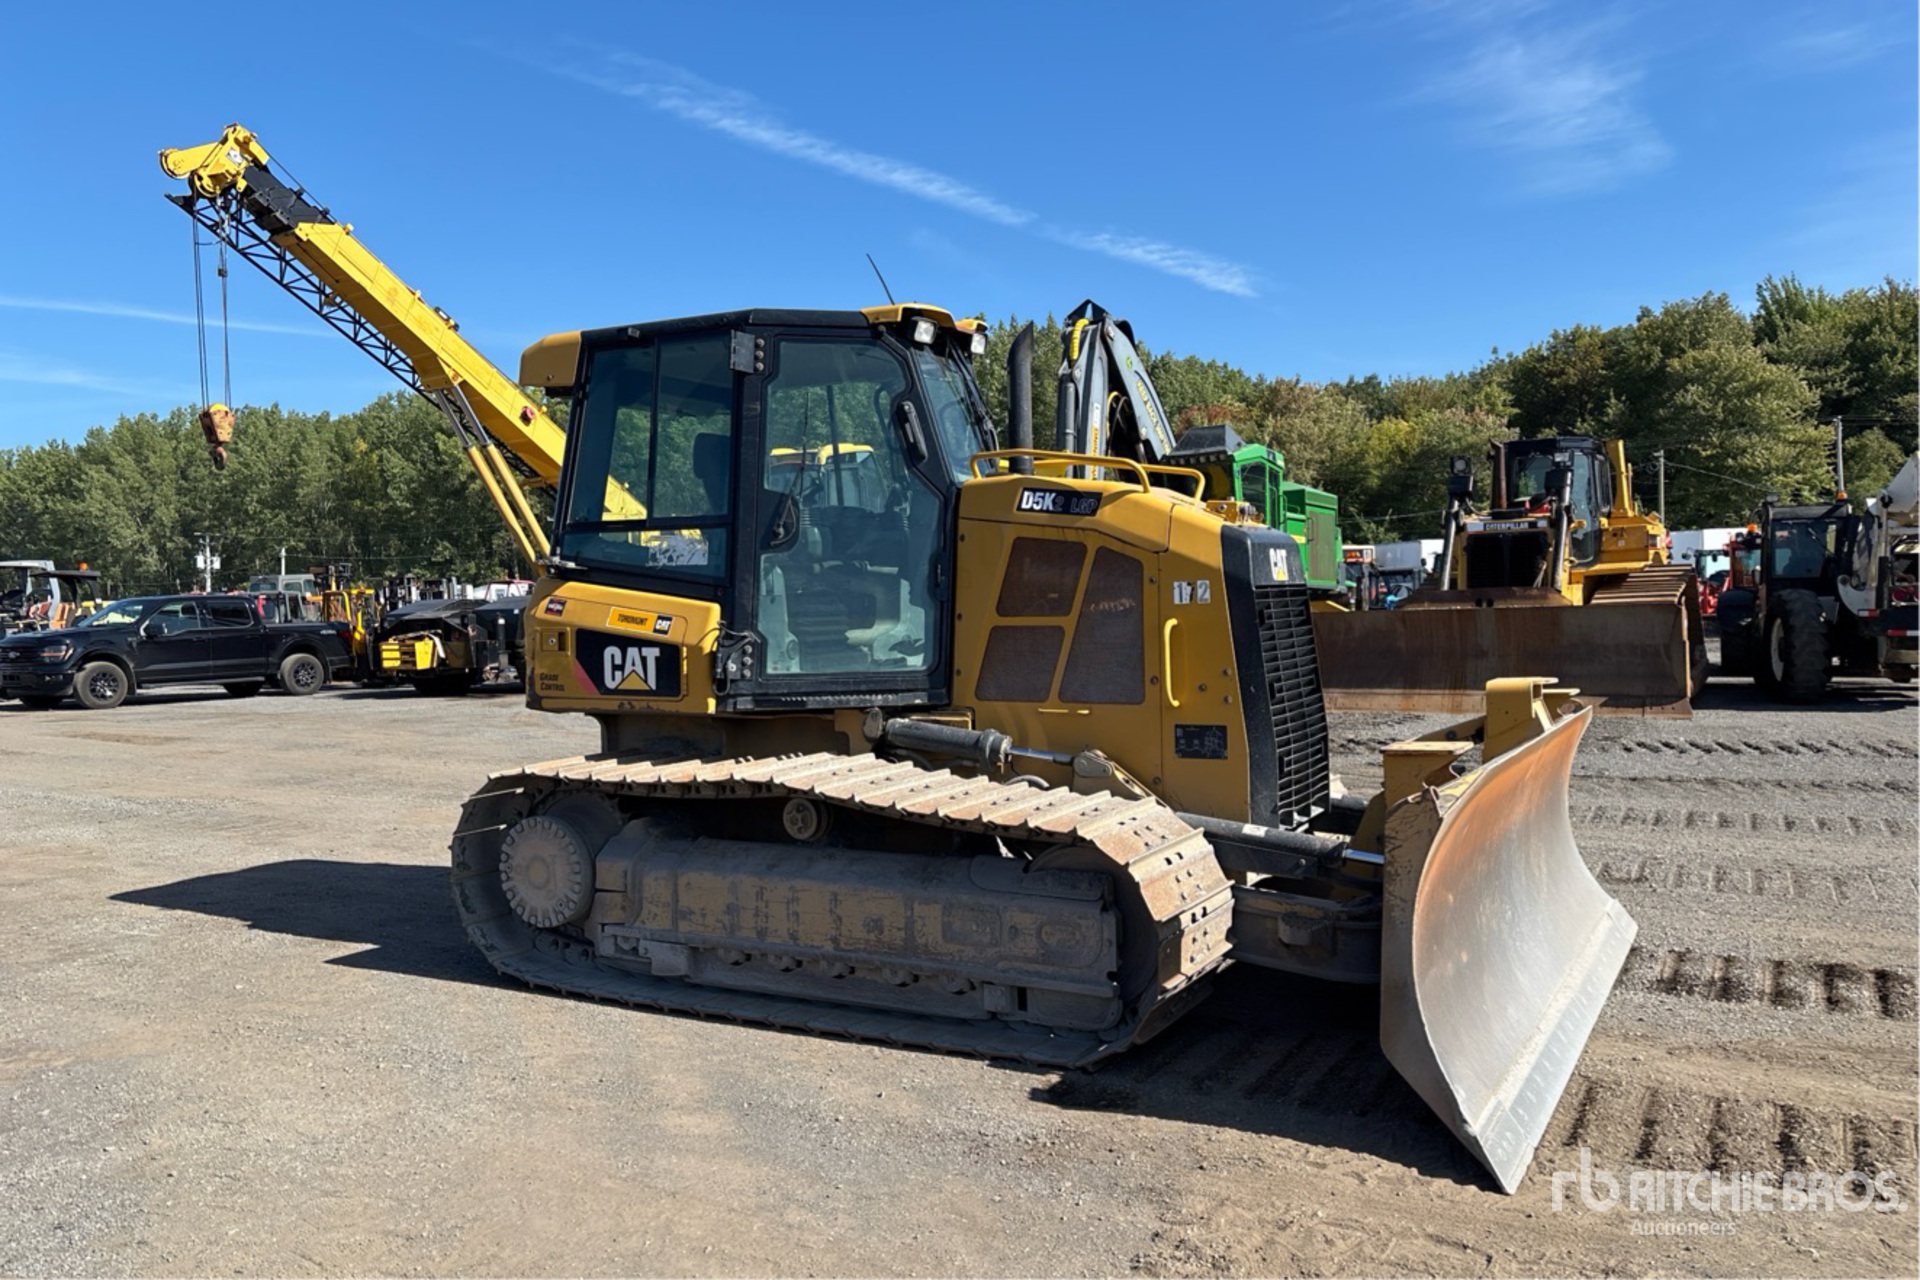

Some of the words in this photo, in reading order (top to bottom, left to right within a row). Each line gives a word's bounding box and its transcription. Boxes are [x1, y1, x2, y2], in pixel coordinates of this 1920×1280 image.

[1021, 491, 1065, 511] D5K2
[1070, 497, 1098, 514] LGP
[1269, 548, 1289, 581] CAT
[656, 620, 671, 630] CAT
[603, 645, 661, 690] CAT
